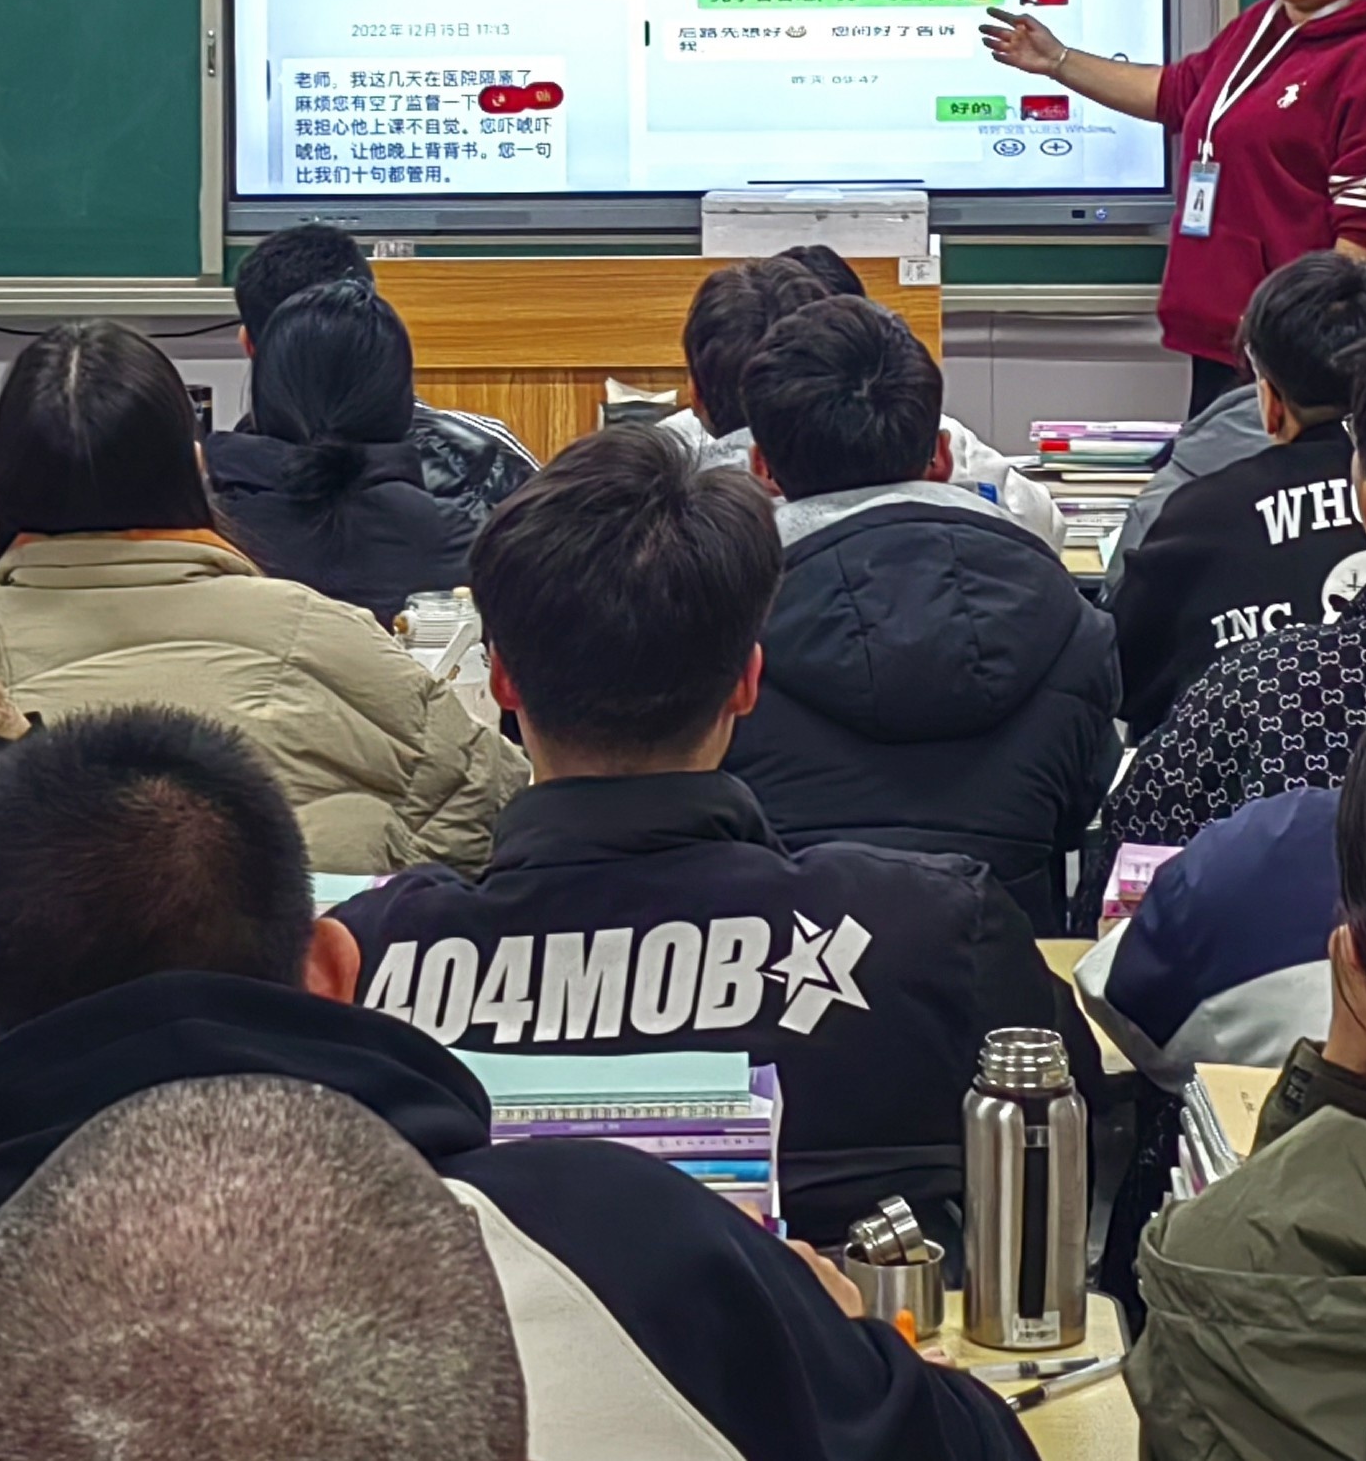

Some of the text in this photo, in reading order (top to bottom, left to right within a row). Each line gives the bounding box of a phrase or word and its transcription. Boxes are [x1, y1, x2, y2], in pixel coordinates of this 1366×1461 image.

[950, 102, 992, 115] 好的
[296, 165, 451, 184] 比我们十句都管用。
[363, 916, 772, 1046] 404MOB
